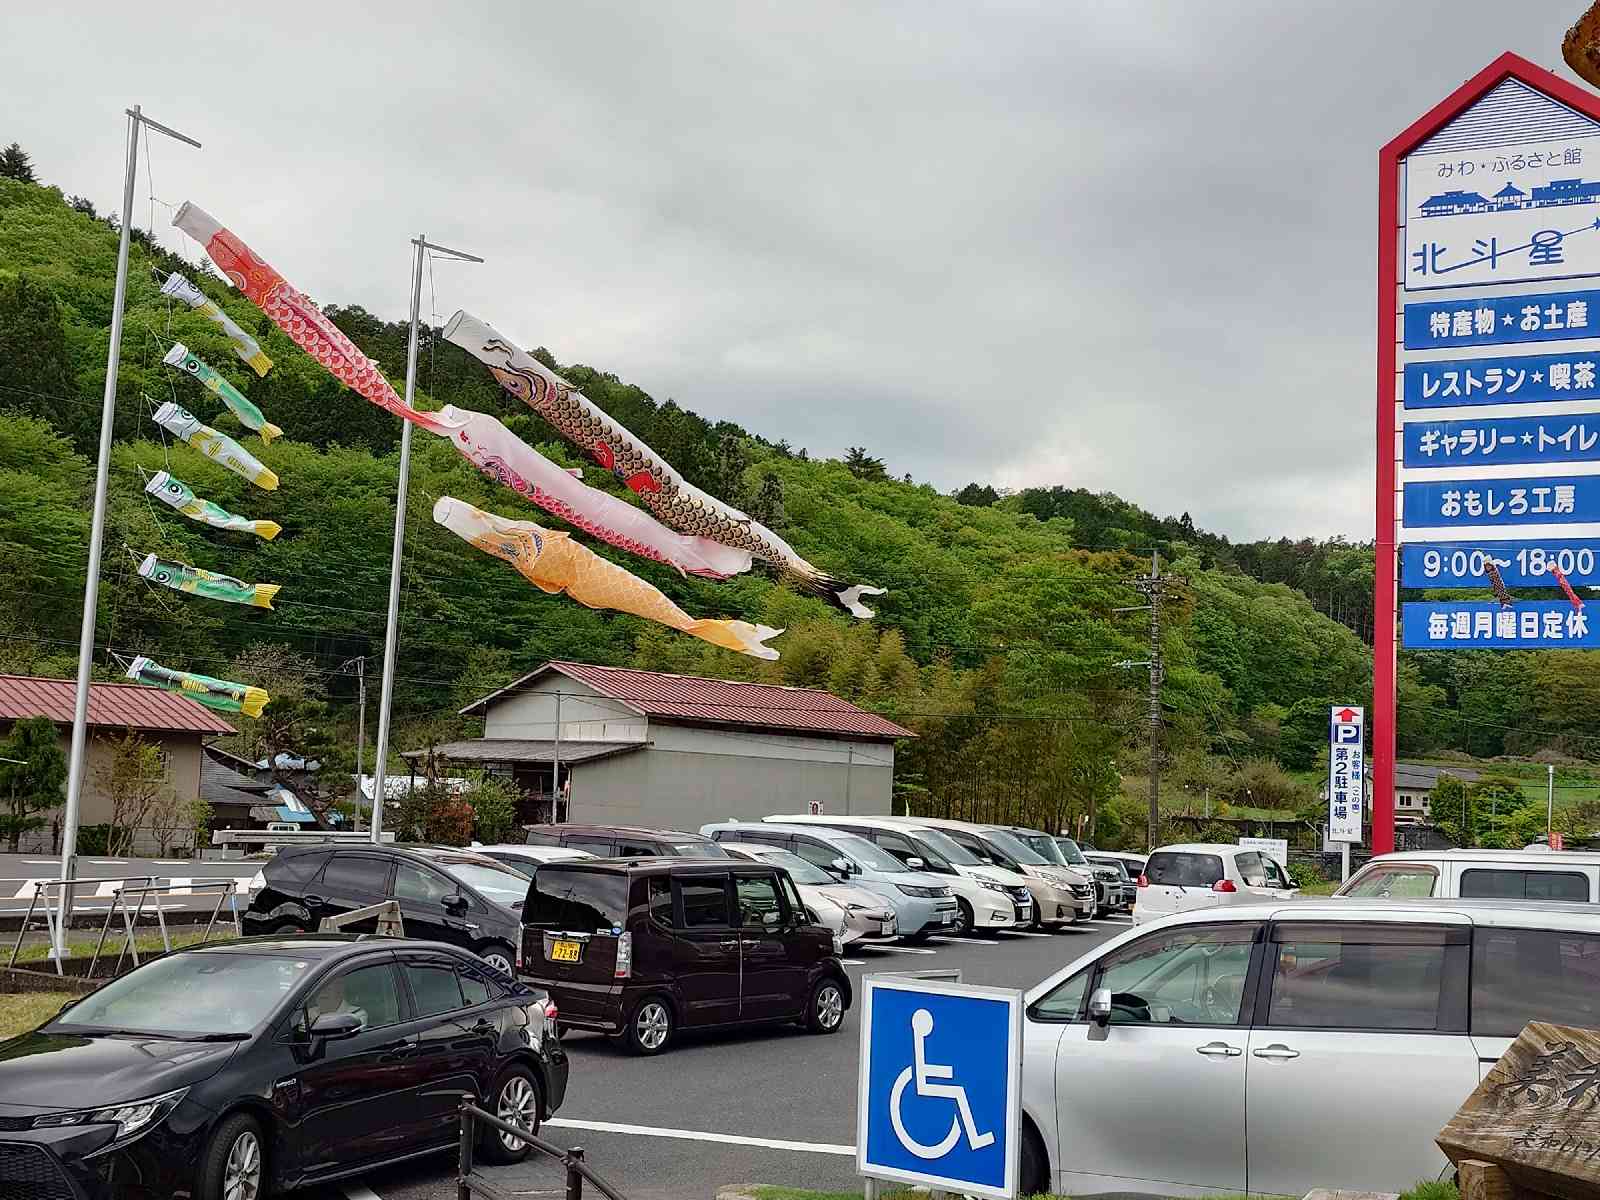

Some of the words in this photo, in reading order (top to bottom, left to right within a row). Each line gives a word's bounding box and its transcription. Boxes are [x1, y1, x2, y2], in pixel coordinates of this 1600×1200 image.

[1438, 148, 1582, 178] みわ・ふるさと館
[1412, 230, 1564, 276] 北斗星
[1430, 307, 1495, 338] 特産物
[1520, 300, 1588, 331] お土産
[1423, 368, 1526, 398] レストラン
[1549, 361, 1596, 391] 喫茶
[1419, 427, 1516, 457] ギャラリー
[1538, 424, 1599, 453] トイレ
[1441, 485, 1576, 517] おもしろ工房
[1428, 610, 1589, 640] 毎週月曜日定休
